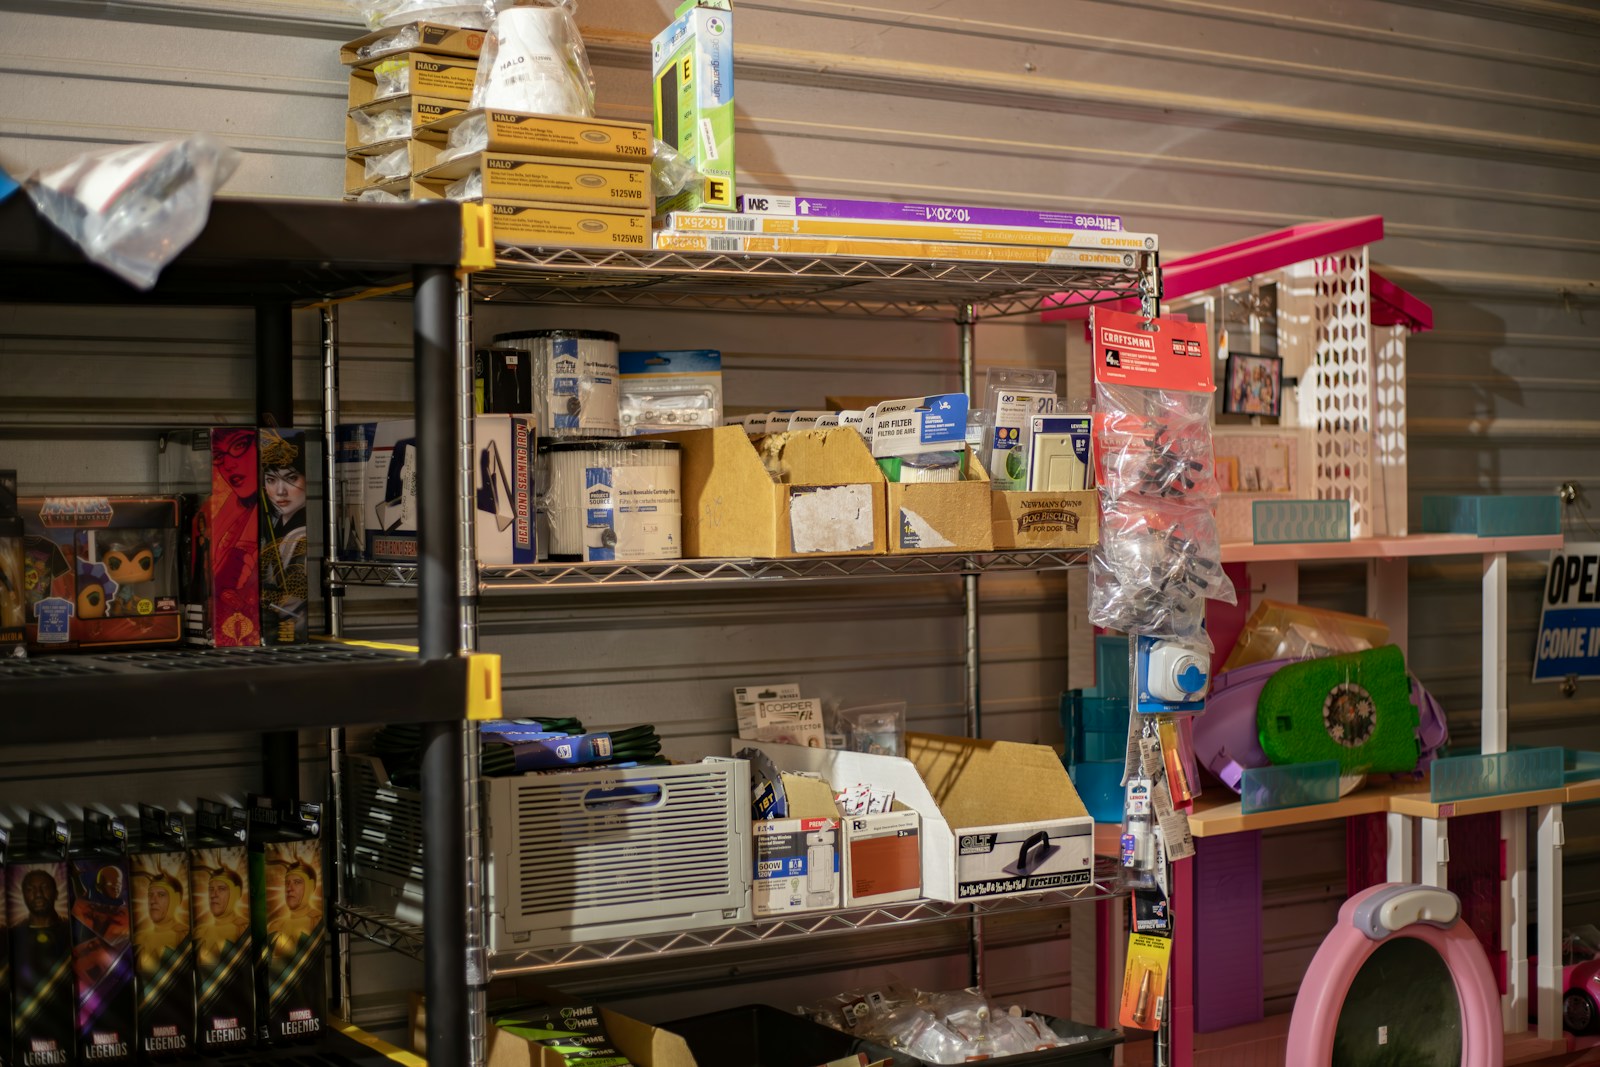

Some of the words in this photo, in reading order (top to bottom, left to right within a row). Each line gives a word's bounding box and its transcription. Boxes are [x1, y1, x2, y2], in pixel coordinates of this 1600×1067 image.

[417, 63, 438, 72] HALO
[500, 56, 525, 72] HALO
[420, 106, 440, 114] HALO
[494, 114, 516, 123] HALO
[616, 145, 647, 156] 5125WB
[489, 160, 512, 168] HALO
[610, 189, 642, 198] 5125WB
[710, 182, 724, 200] E
[493, 206, 514, 214] HALO
[748, 198, 768, 211] 3M
[677, 216, 724, 230] 16x25x1
[1075, 216, 1120, 232] Filtrete
[612, 234, 644, 244] 5125WB
[1100, 237, 1142, 248] ENHANCED
[1079, 252, 1121, 263] ENHANCED
[1104, 332, 1150, 348] CRAFTSMAN
[1038, 398, 1053, 413] 20
[878, 421, 890, 429] AIR
[891, 419, 912, 427] FILTER
[516, 424, 528, 448] IRON
[516, 449, 528, 490] SEAMING
[516, 492, 528, 516] BOND
[1020, 500, 1058, 508] NEWMAN'S
[1022, 513, 1040, 524] DOG
[1041, 512, 1075, 523] BISCUITS
[516, 518, 528, 544] HEAT
[1540, 627, 1587, 660] COME
[766, 701, 812, 712] COPPER
[800, 710, 813, 720] fit
[1062, 872, 1089, 884] TROWEL
[572, 1006, 594, 1017] HME
[281, 1018, 320, 1035] LEGENDS
[577, 1018, 599, 1028] HME
[206, 1028, 246, 1043] LEGENDS
[583, 1036, 605, 1044] HME
[145, 1035, 186, 1050] LEGENDS
[86, 1043, 127, 1059] LEGENDS
[24, 1050, 66, 1066] LEGENDS
